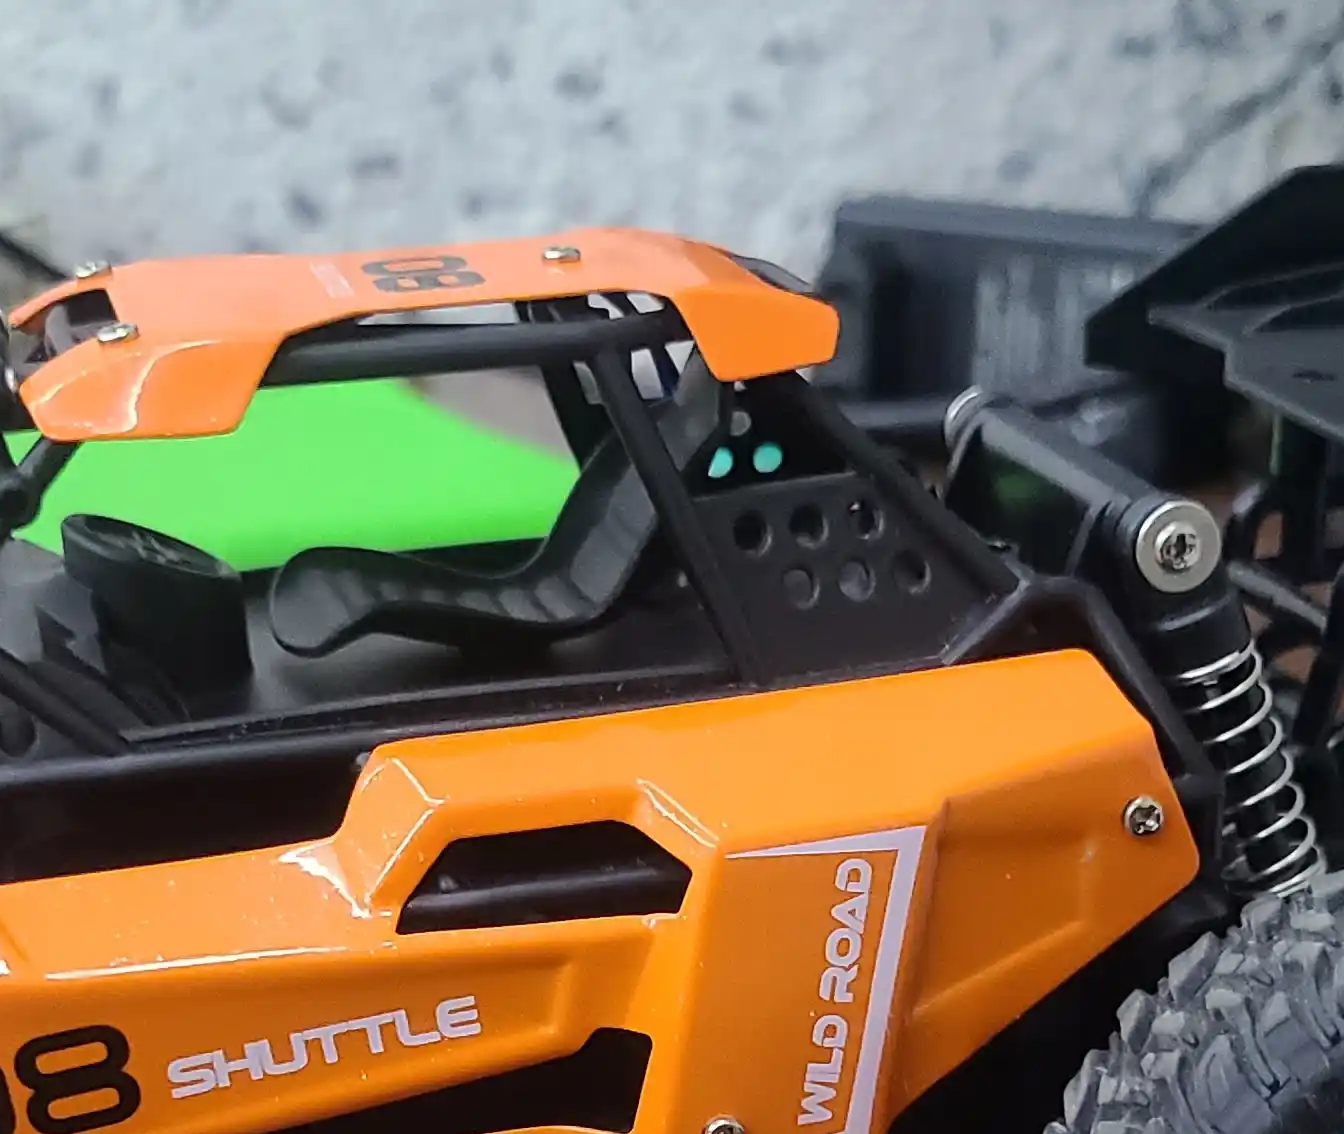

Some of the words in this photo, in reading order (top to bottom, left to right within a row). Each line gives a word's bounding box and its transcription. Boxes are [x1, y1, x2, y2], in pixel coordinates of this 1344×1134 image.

[818, 857, 873, 1004] ROAD
[167, 995, 482, 1100] SHUTTLE
[797, 1014, 848, 1127] WILD
